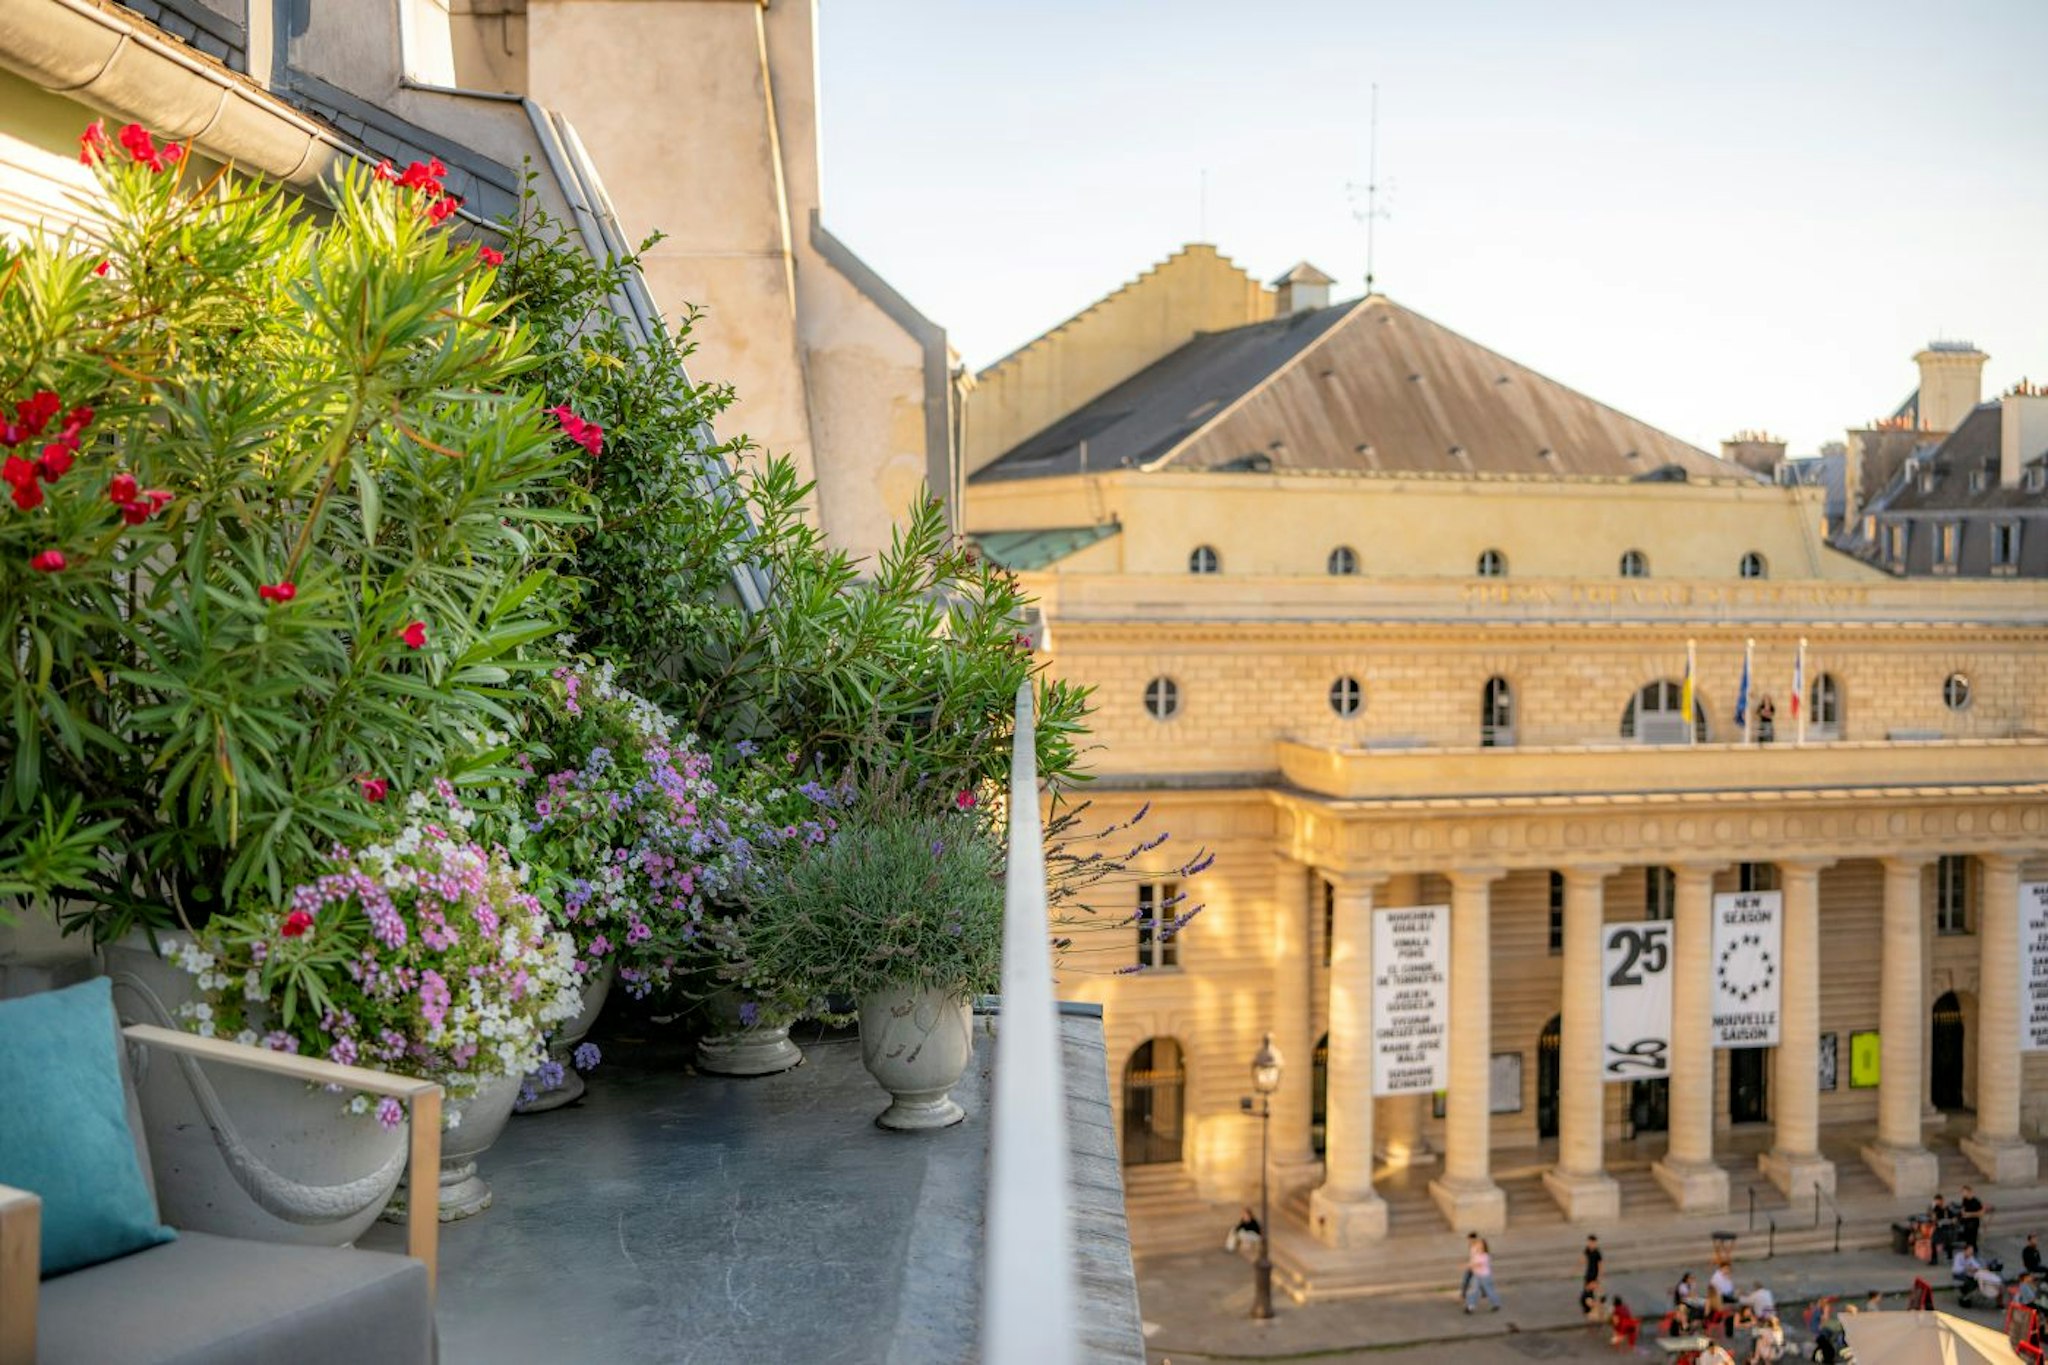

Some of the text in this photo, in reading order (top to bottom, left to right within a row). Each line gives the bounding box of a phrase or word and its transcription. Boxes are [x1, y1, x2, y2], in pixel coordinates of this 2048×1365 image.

[1734, 897, 1761, 908] NEW
[1723, 911, 1772, 924] SEASON
[1608, 928, 1668, 987] 25
[1712, 1011, 1777, 1026] NOUVELLE
[1720, 1028, 1768, 1041] SAISON
